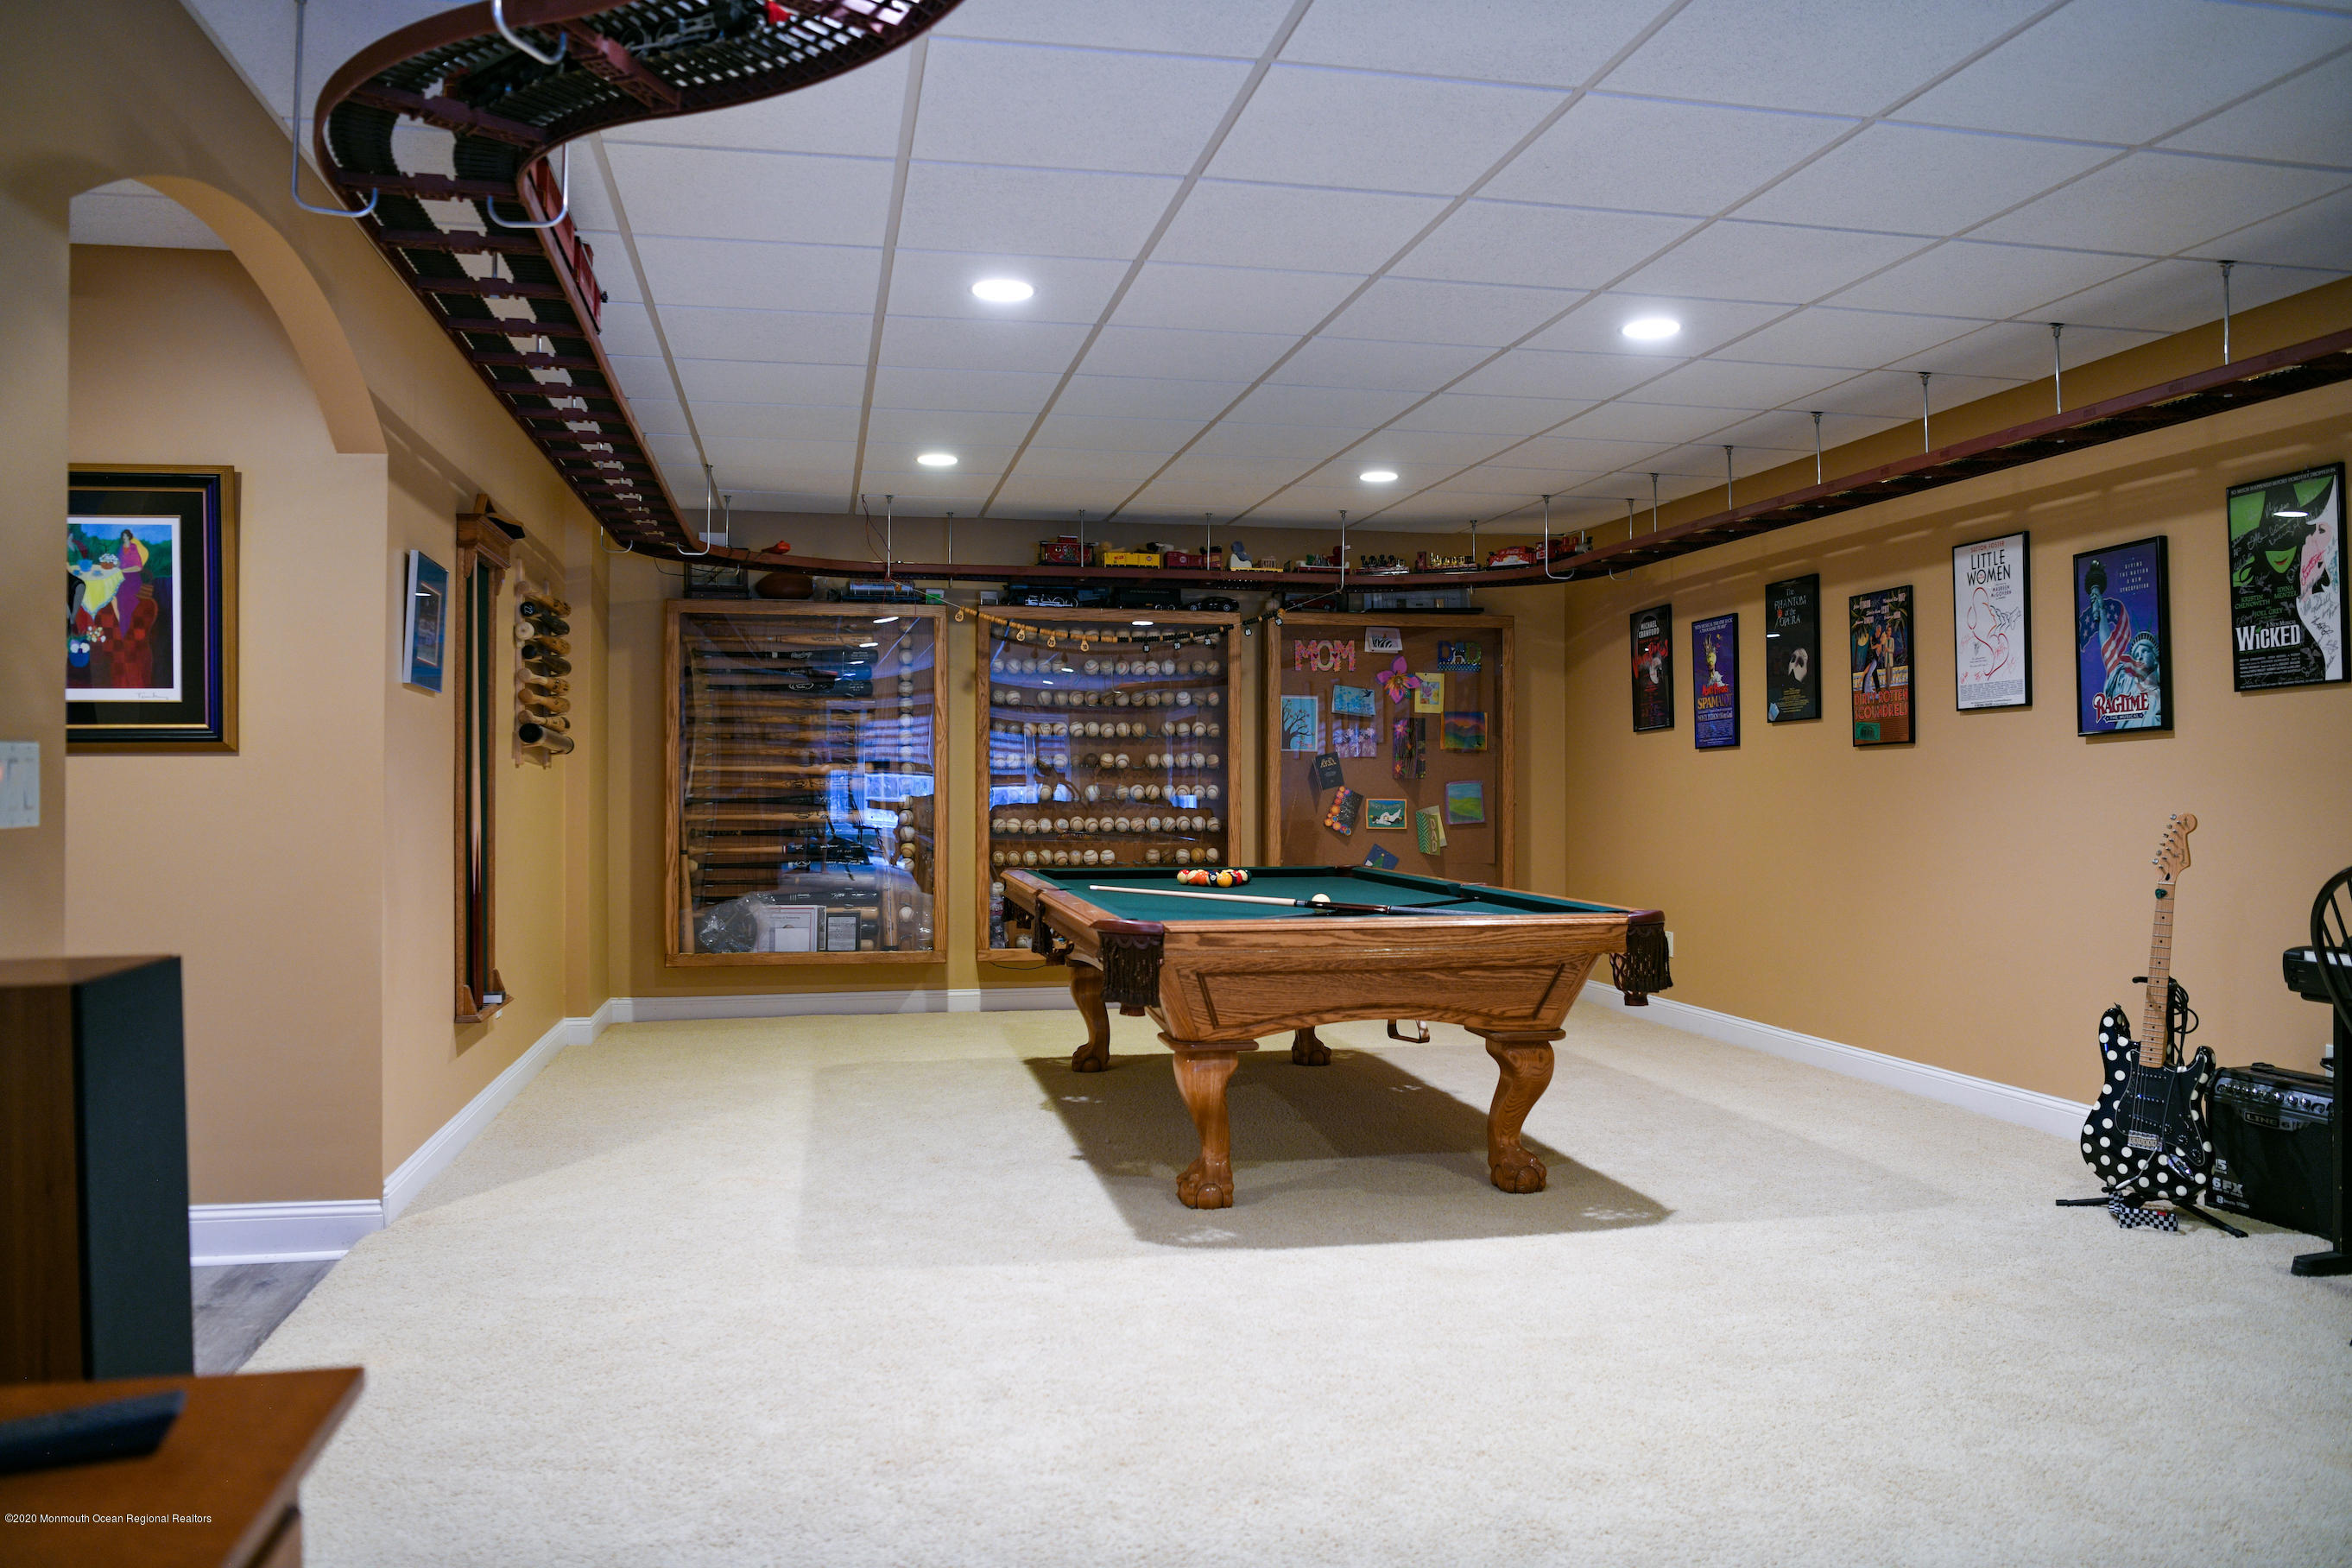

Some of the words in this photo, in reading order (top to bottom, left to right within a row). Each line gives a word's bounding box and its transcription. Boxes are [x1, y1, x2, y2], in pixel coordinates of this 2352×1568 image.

[1970, 549, 2005, 570] LITTLE
[1967, 564, 2011, 586] WOMEN
[1774, 595, 1807, 610] PHANTOM
[1779, 614, 1801, 627] OPERA
[2254, 609, 2267, 617] JOEL
[2267, 607, 2285, 616] GREY
[1638, 626, 1660, 639] CRAWFORD
[1640, 619, 1658, 632] MICHAEL
[2235, 624, 2301, 652] WICKED
[1294, 640, 1356, 672] MOM
[1438, 640, 1482, 665] DAD
[1697, 692, 1734, 710] SPAMALOT
[1854, 692, 1876, 705] DIRTY
[1878, 688, 1909, 703] ROTTEN
[1854, 702, 1909, 720] SCOUNDRELS
[2093, 692, 2150, 724] RAGTIME
[1429, 818, 1438, 853] DAD
[2246, 1113, 2279, 1128] LINE
